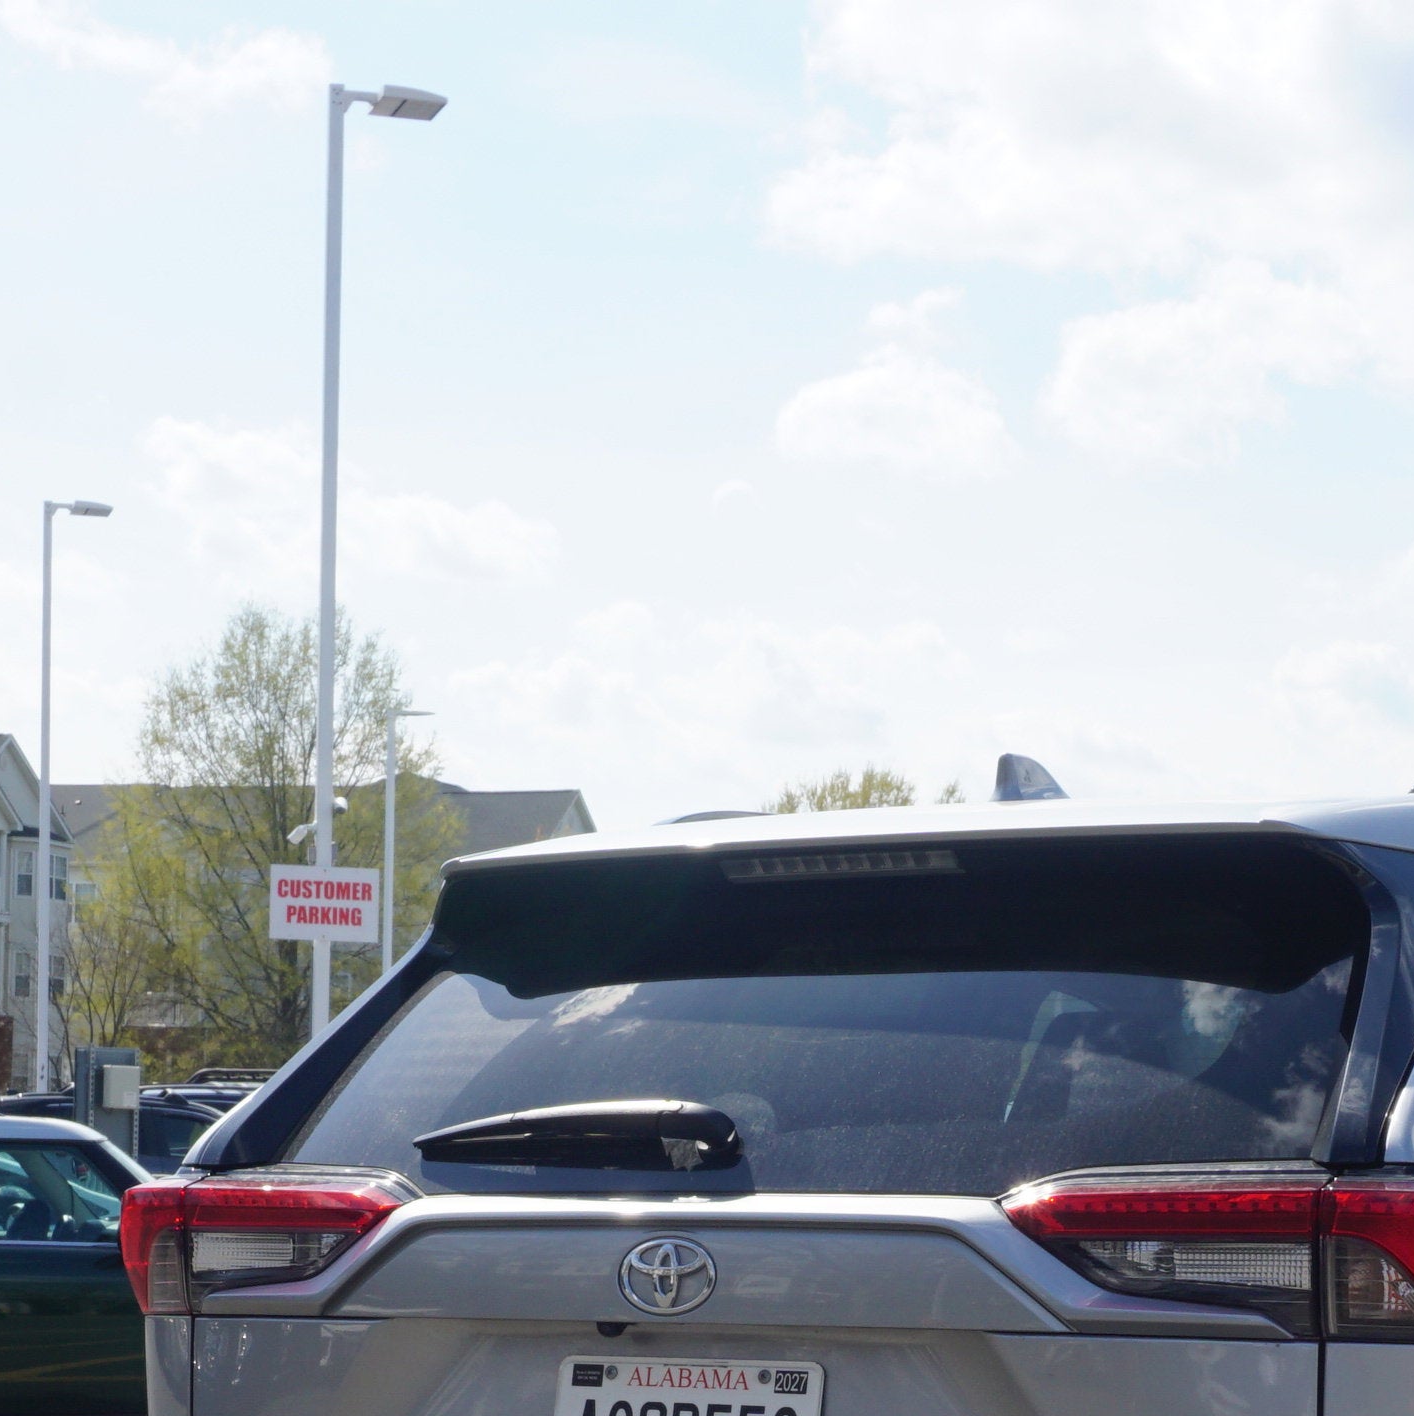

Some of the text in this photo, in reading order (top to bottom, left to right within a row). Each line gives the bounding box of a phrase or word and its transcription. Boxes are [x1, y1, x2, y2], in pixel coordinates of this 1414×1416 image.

[277, 879, 372, 901] CUSTOMER
[286, 905, 362, 927] PARKING
[627, 1366, 749, 1391] ALABAMA
[774, 1372, 808, 1393] 2027
